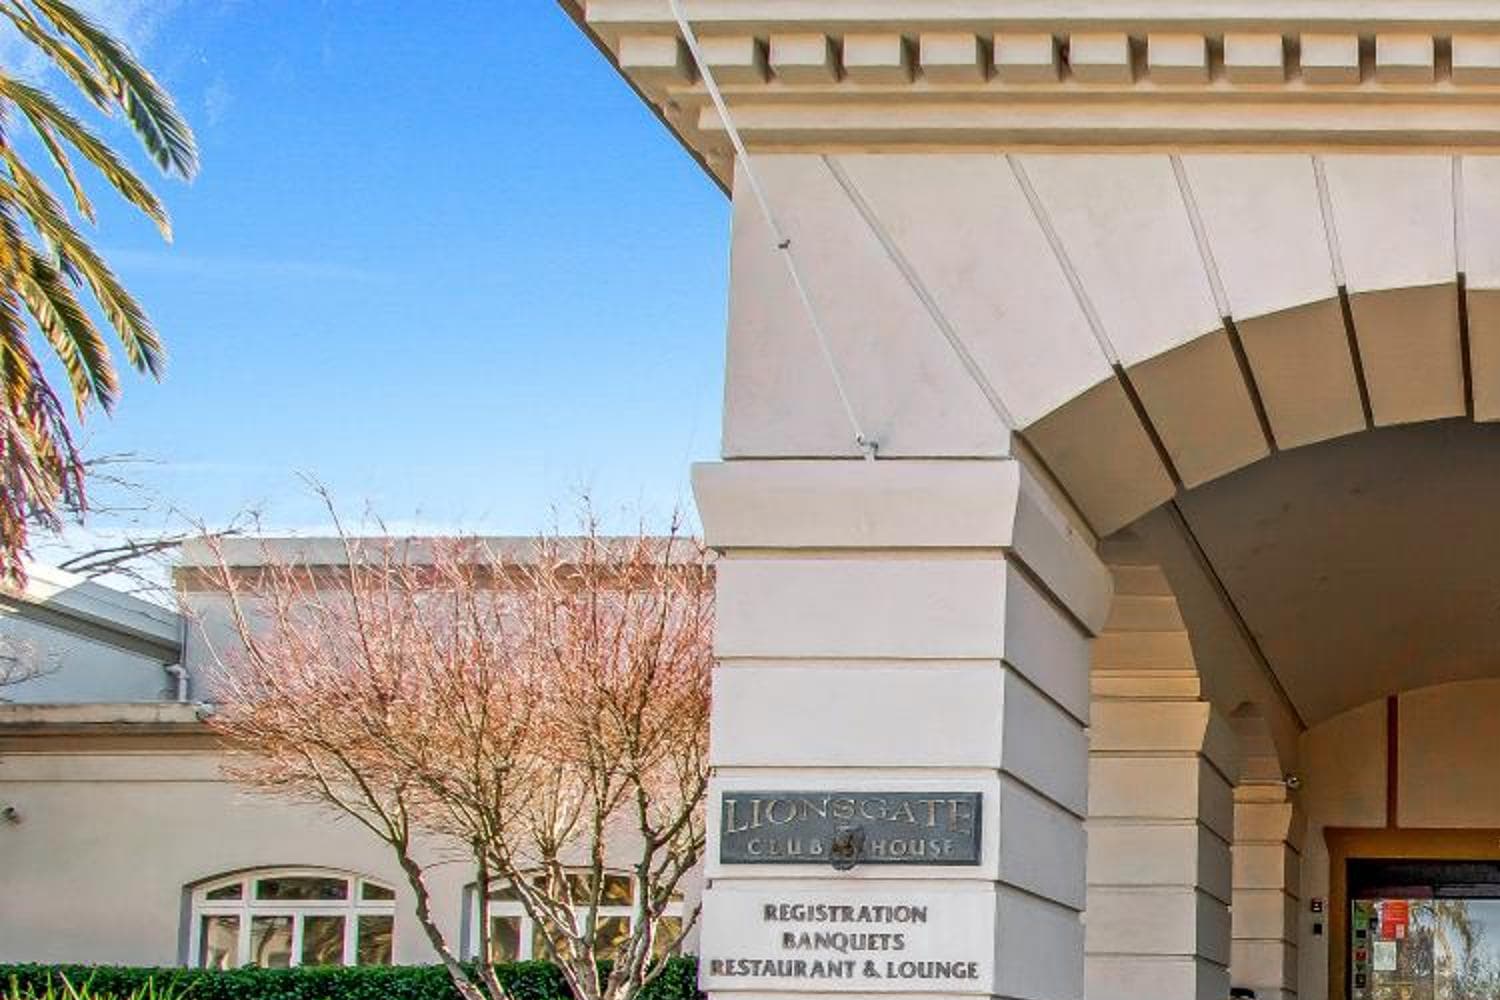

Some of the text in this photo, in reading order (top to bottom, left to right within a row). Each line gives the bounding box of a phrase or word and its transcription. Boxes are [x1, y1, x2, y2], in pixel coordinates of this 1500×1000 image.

[724, 798, 973, 834] LIONSGATE
[748, 838, 954, 856] CLUB HOUSE
[763, 903, 928, 924] REGISTRATION
[782, 932, 906, 952] BANQUETS
[710, 959, 979, 980] RESTAURANT & LOUNGE
